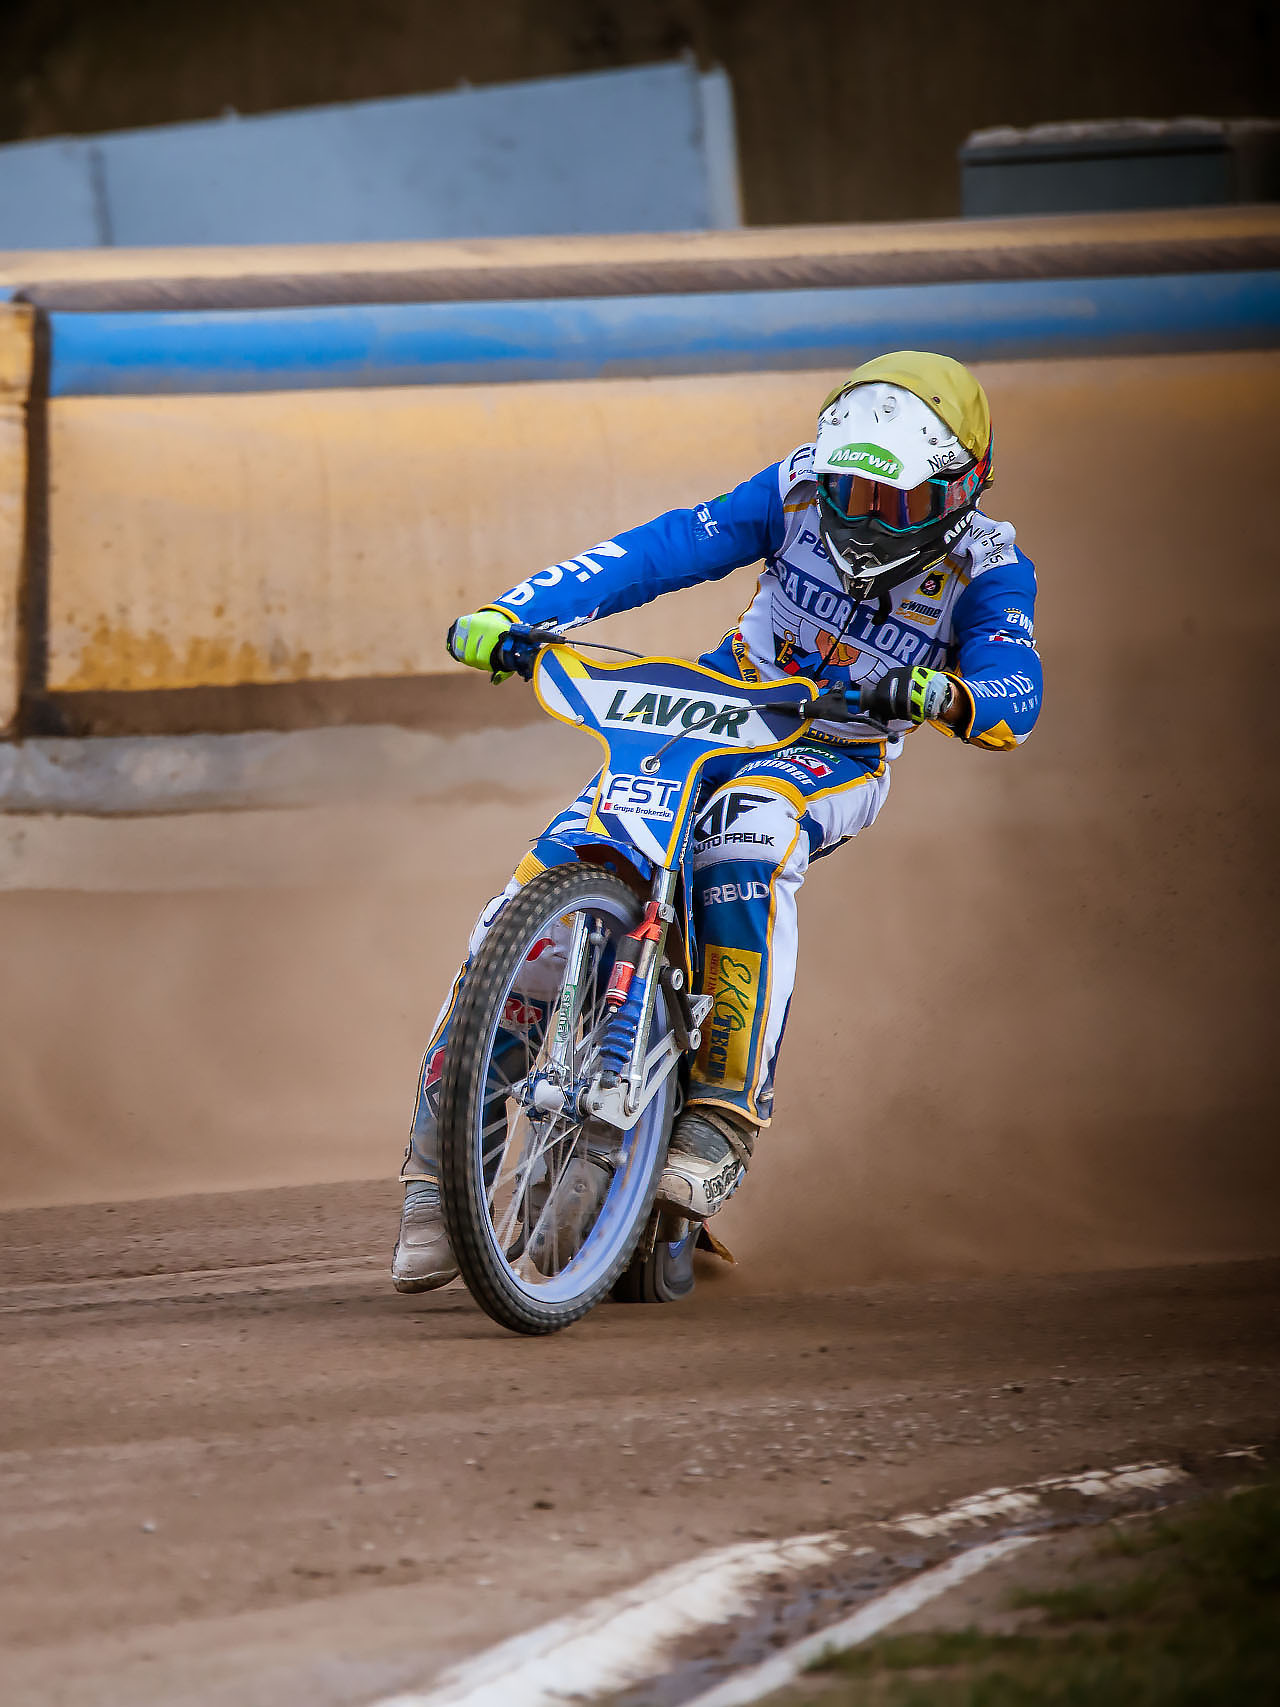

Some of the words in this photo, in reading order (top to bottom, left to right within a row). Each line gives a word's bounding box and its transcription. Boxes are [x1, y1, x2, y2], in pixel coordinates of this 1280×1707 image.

[832, 449, 899, 475] Marwit
[927, 450, 957, 473] Nice
[499, 540, 628, 606] Nice
[605, 689, 751, 739] LAVOR
[607, 775, 680, 808] FST
[724, 832, 775, 847] FRELIK
